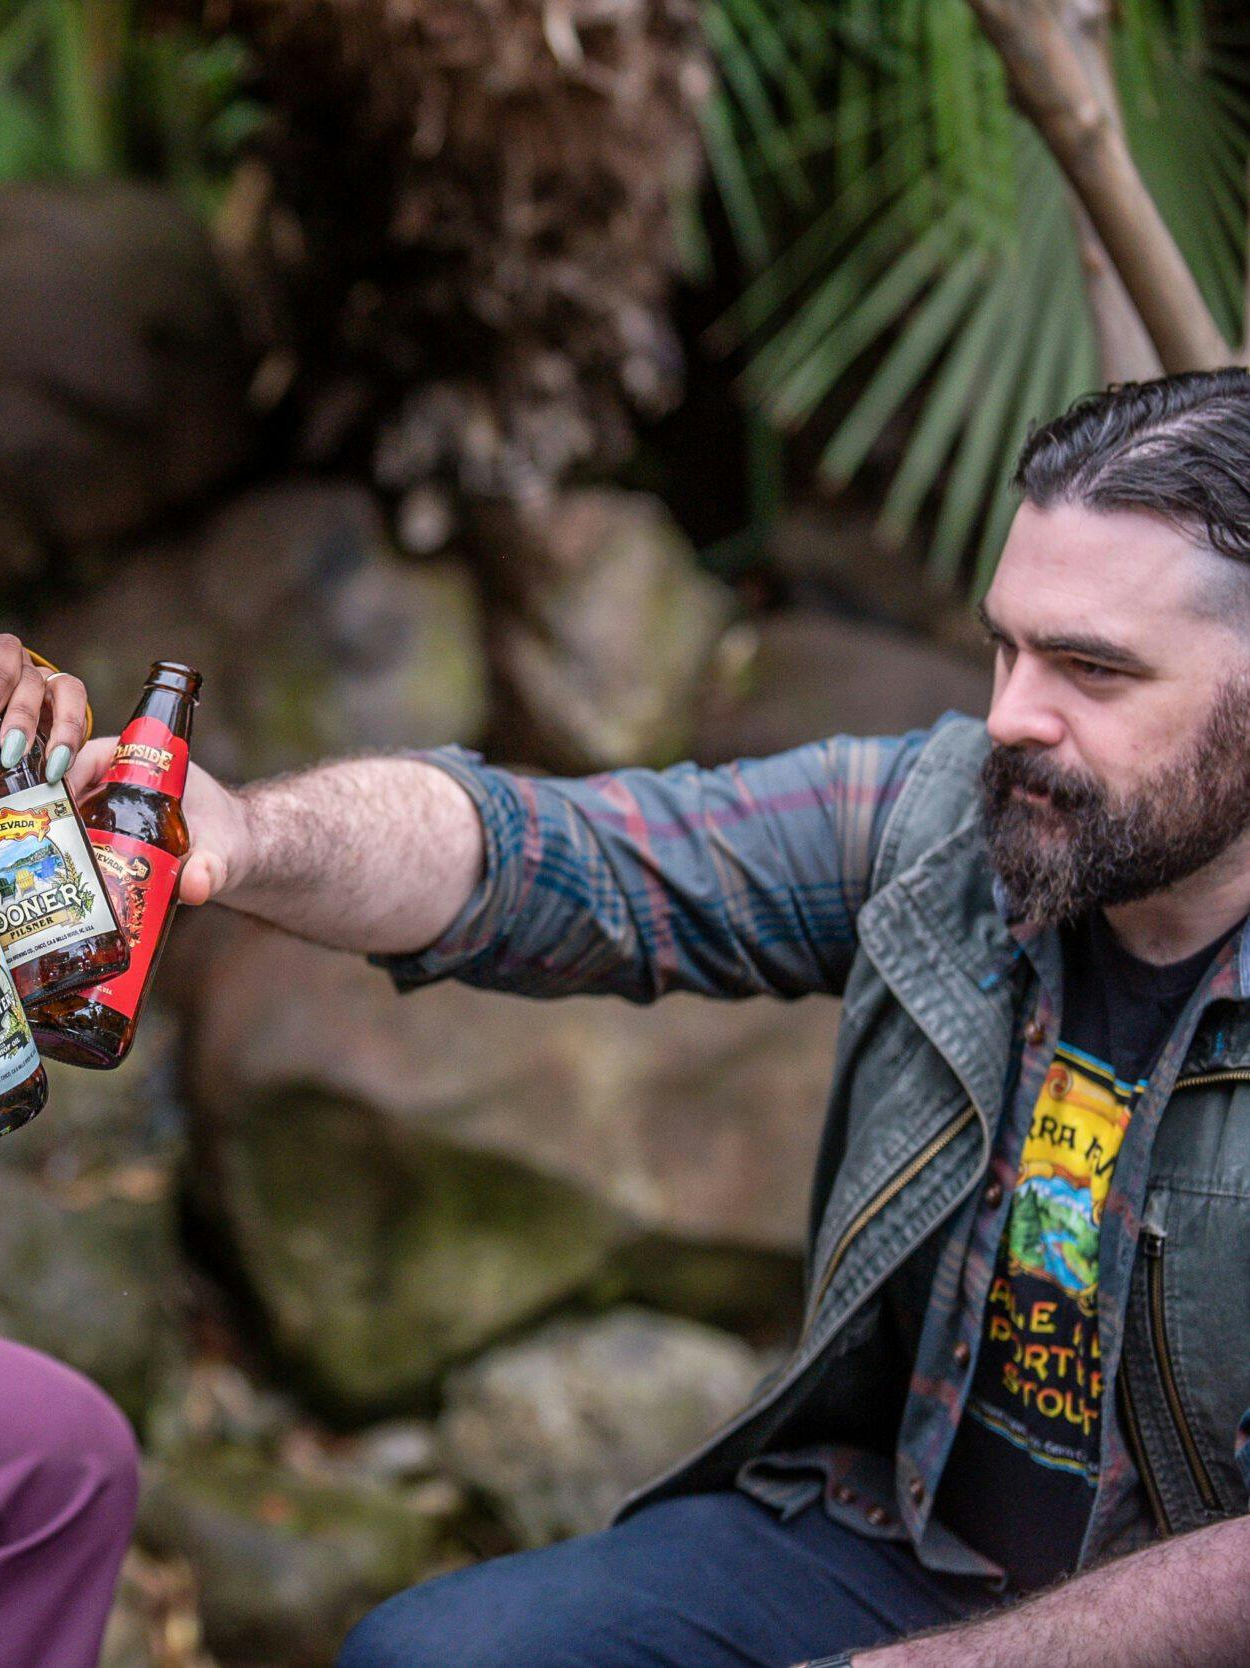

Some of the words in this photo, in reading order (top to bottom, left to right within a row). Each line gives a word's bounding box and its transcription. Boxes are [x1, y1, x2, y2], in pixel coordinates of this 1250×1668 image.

[114, 744, 173, 771] LIPSIDE
[94, 852, 124, 873] EVADA
[10, 916, 54, 940] PILSNER
[0, 1044, 11, 1057] HOP
[11, 1037, 21, 1047] OIL
[1003, 1361, 1100, 1437] STOUT
